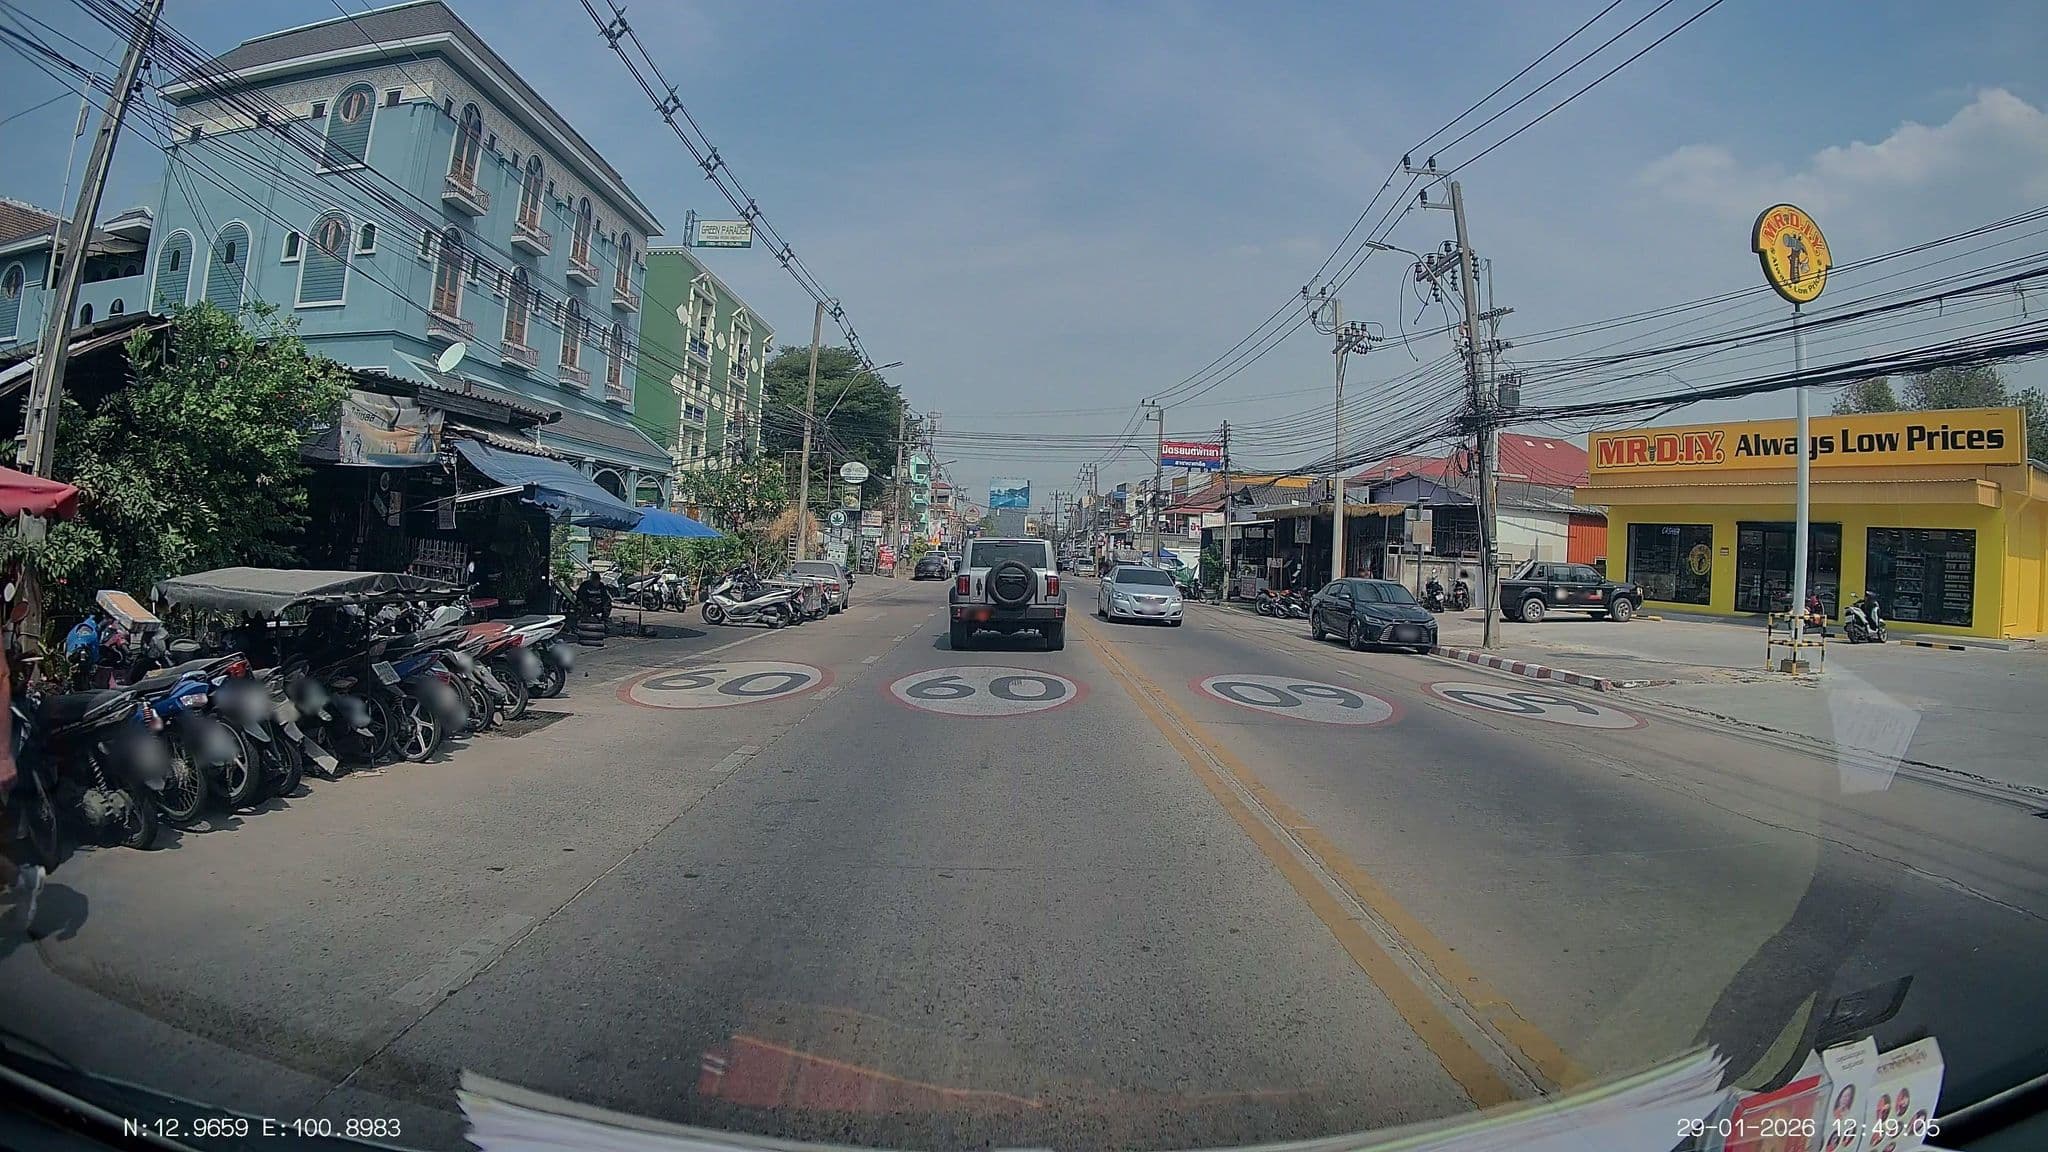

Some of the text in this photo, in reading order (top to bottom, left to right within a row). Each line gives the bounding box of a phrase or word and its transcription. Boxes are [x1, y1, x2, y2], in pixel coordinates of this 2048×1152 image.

[1735, 434, 1834, 460] Always
[1841, 428, 1900, 453] Low
[1907, 425, 2004, 451] Prices
[642, 669, 810, 697] 60
[905, 674, 1064, 702] 60
